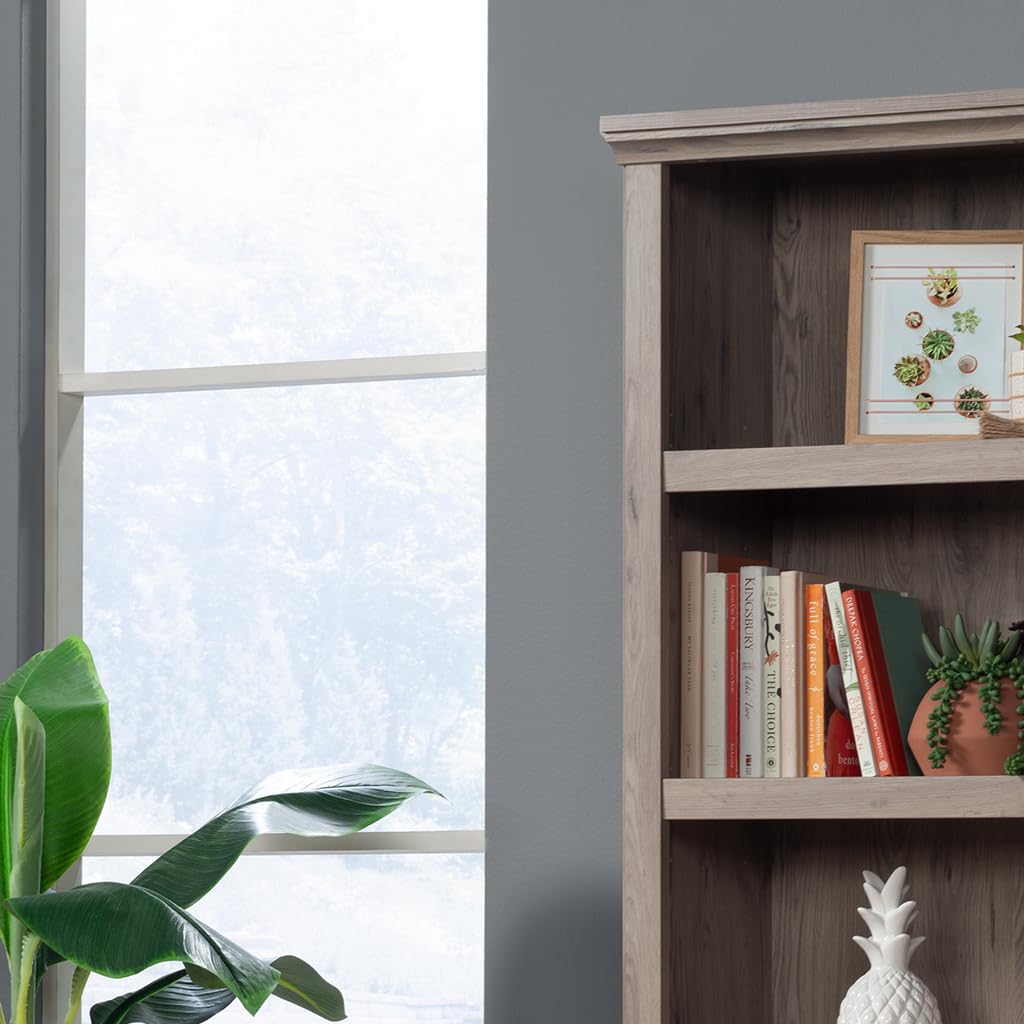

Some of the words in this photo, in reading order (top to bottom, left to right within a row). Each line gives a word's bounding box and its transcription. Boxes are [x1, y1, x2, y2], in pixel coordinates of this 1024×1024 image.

[744, 577, 756, 650] KINGSBURY
[809, 601, 819, 623] full
[846, 596, 857, 627] DEEPAK
[808, 628, 819, 641] of
[808, 643, 817, 676] grace
[767, 670, 776, 698] THE
[767, 702, 776, 753] CHOICE
